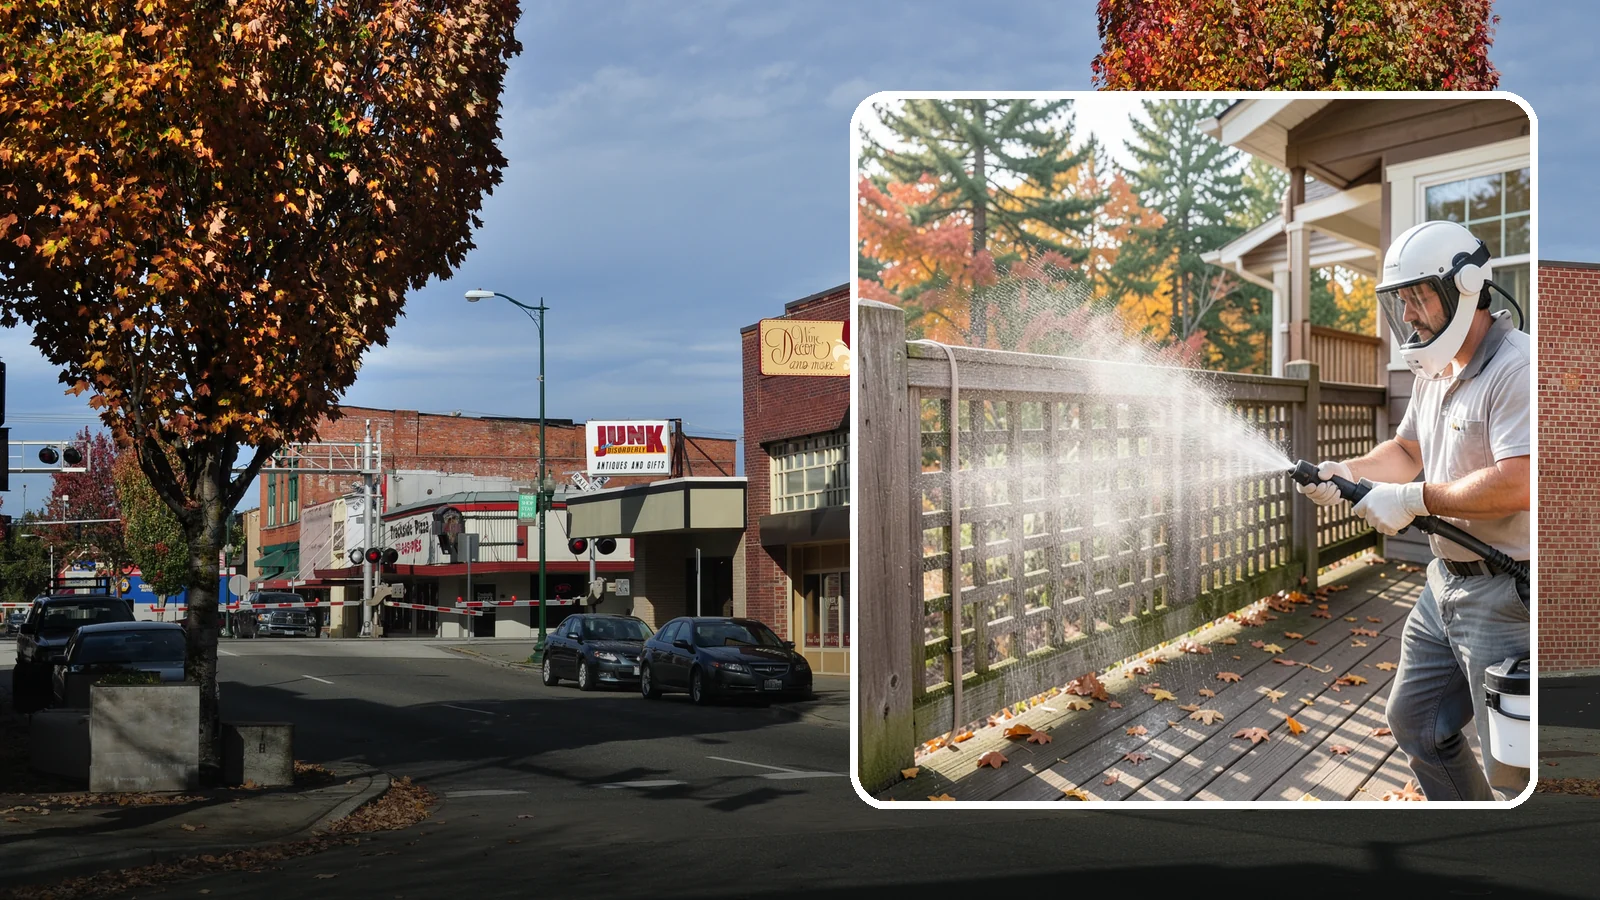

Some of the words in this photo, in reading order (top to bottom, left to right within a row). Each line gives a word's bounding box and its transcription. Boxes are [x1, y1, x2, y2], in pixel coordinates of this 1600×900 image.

[595, 425, 665, 457] JUNK
[607, 446, 646, 454] DISORDERLY
[597, 461, 628, 470] ANTIQUES
[631, 461, 644, 470] AND
[647, 460, 665, 469] GIFTS
[415, 519, 429, 534] Pizza
